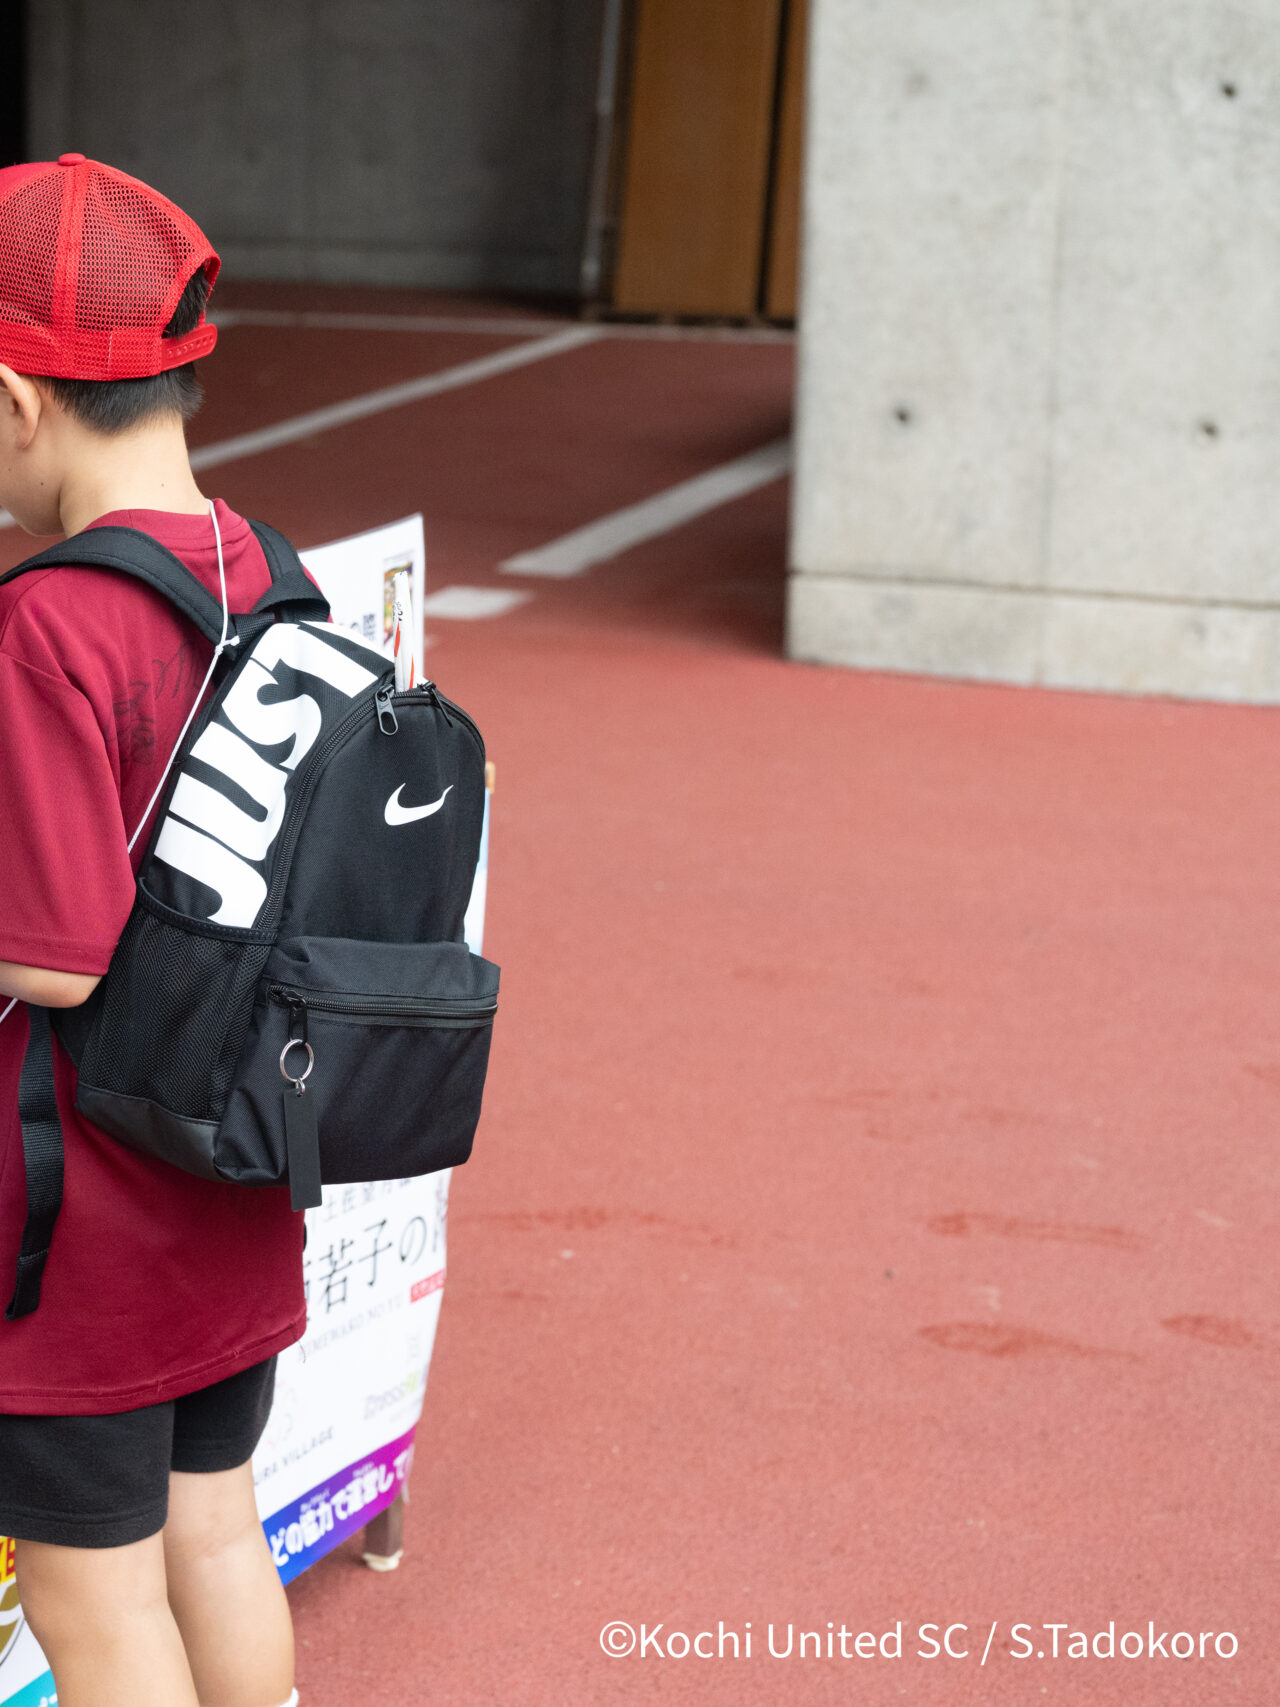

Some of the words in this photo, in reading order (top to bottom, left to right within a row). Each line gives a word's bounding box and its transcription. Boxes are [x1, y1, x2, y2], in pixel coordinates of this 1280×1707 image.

[154, 621, 379, 929] JUST
[304, 1216, 438, 1322] 若子の
